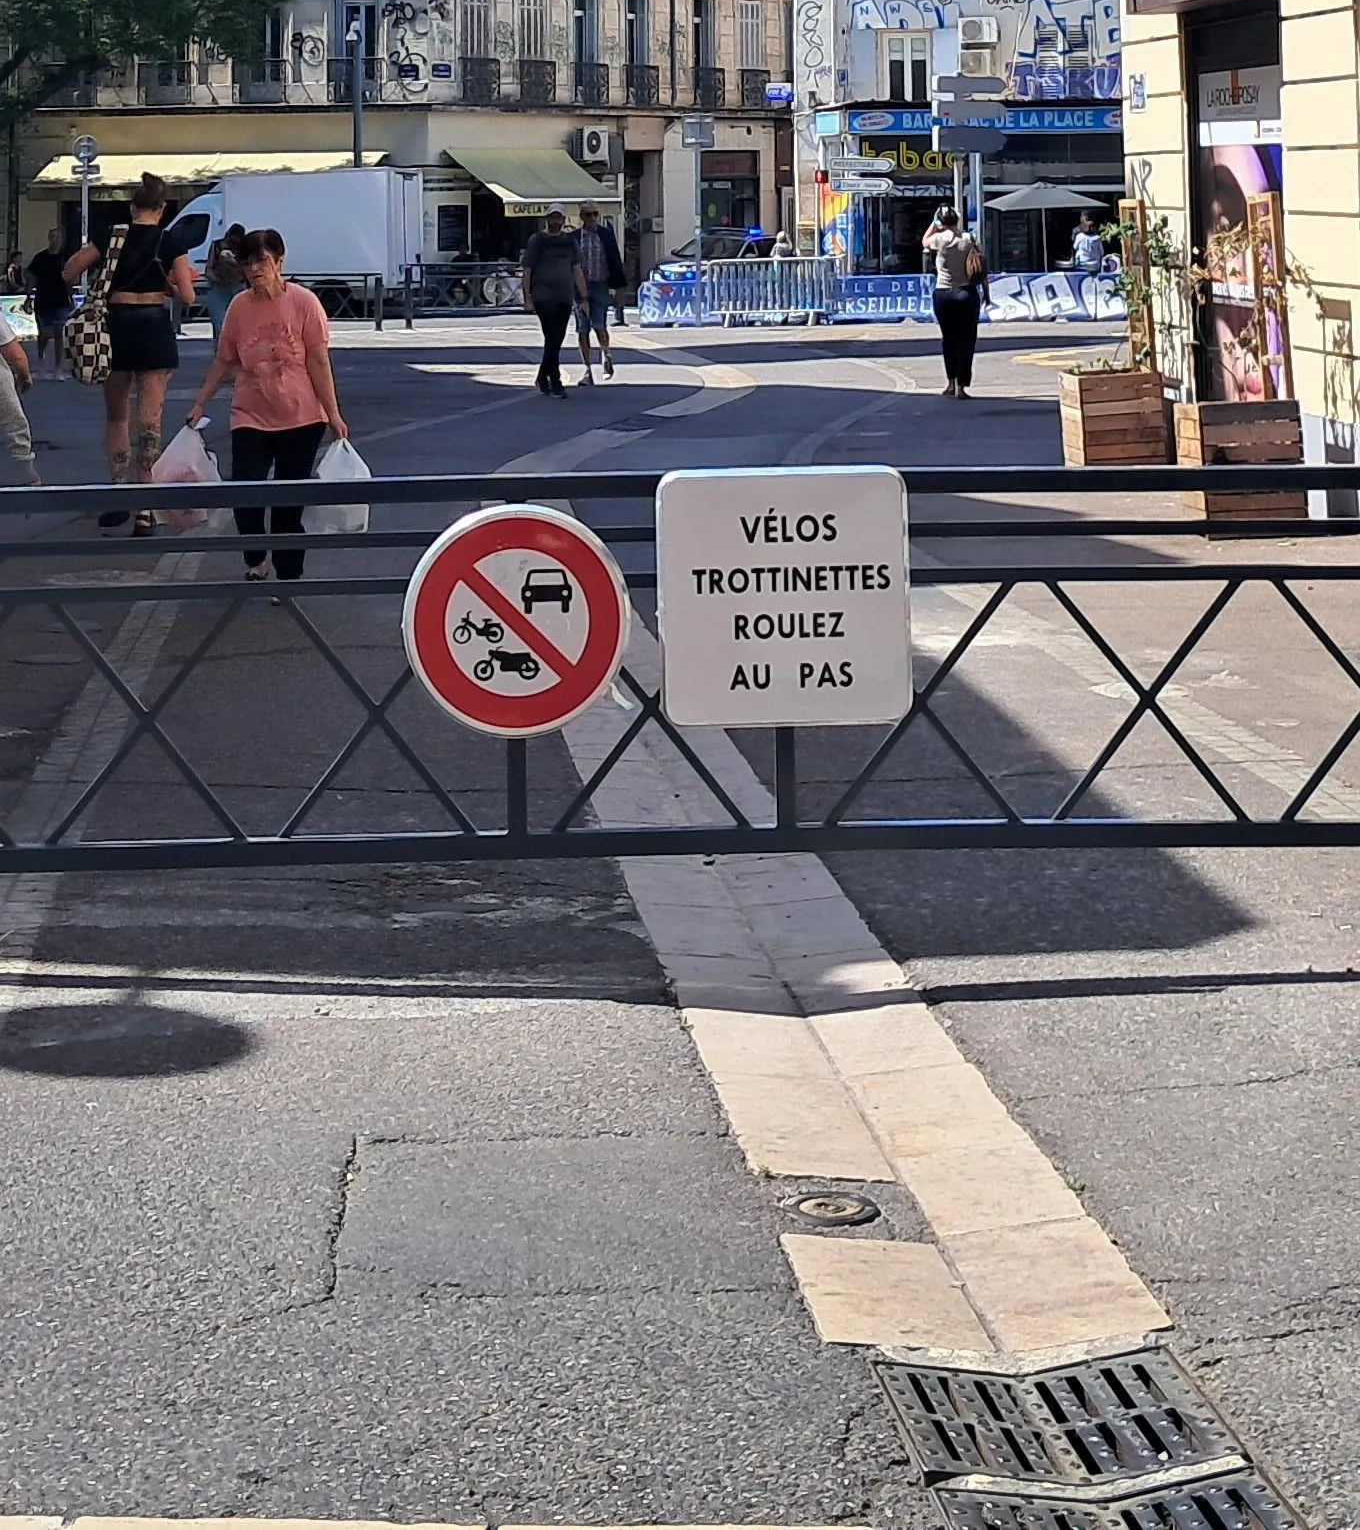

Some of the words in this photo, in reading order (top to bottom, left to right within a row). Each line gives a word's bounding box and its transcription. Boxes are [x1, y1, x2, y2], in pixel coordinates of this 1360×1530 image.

[902, 112, 933, 129] BAR
[1020, 111, 1039, 127] LA
[1044, 110, 1094, 127] PLACE
[740, 508, 838, 544] VÉLOS
[692, 564, 891, 595] TROTTINETTES
[733, 612, 845, 640] ROULEZ
[730, 664, 771, 691] AU
[800, 662, 853, 689] PAS
